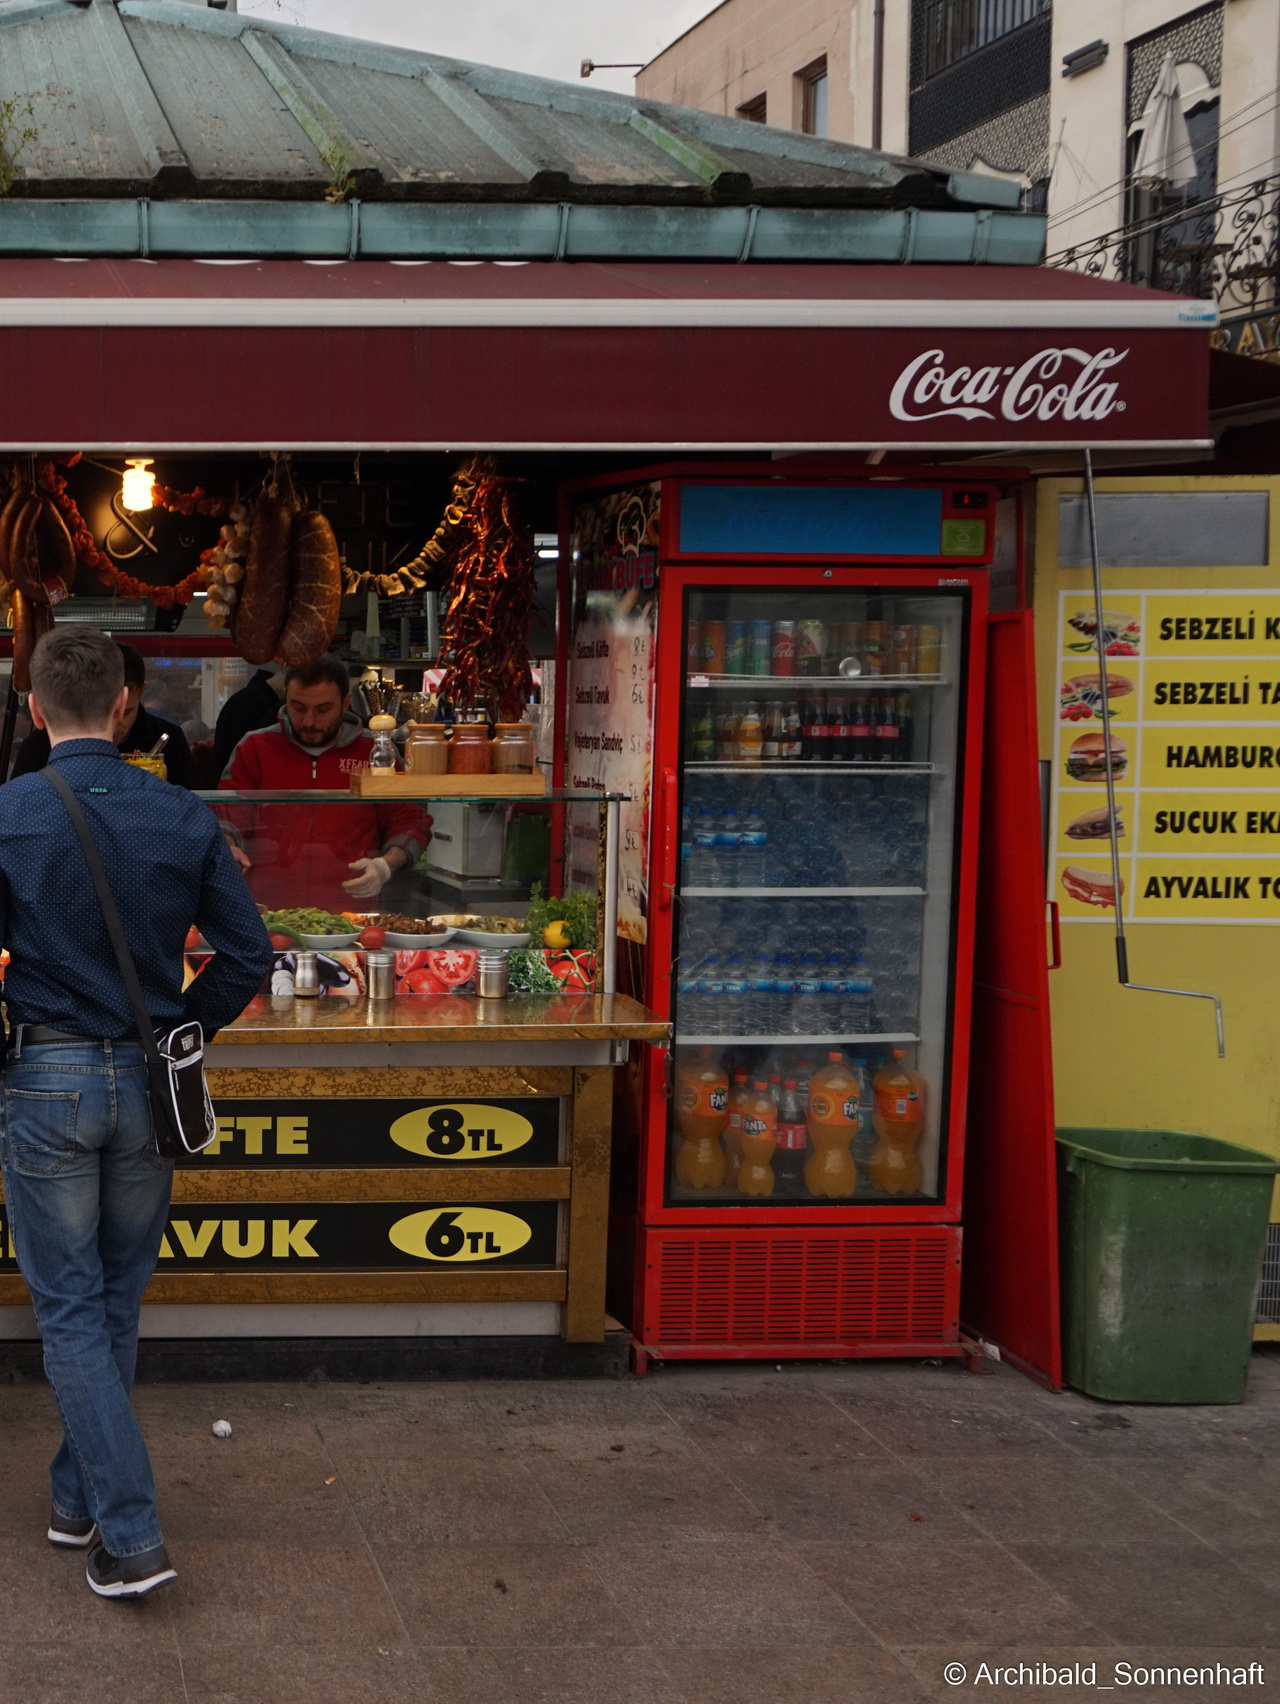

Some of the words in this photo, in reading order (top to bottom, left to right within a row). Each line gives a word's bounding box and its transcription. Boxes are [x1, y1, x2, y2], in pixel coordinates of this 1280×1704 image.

[888, 346, 1130, 422] Coca-Cola
[1159, 609, 1255, 641] SEBZELİ
[1154, 674, 1249, 705] SEBZELİ
[1154, 810, 1237, 834] SUCUK
[1143, 876, 1251, 899] AYVALIK
[202, 1116, 309, 1155] FTE
[743, 1119, 767, 1131] FANTA
